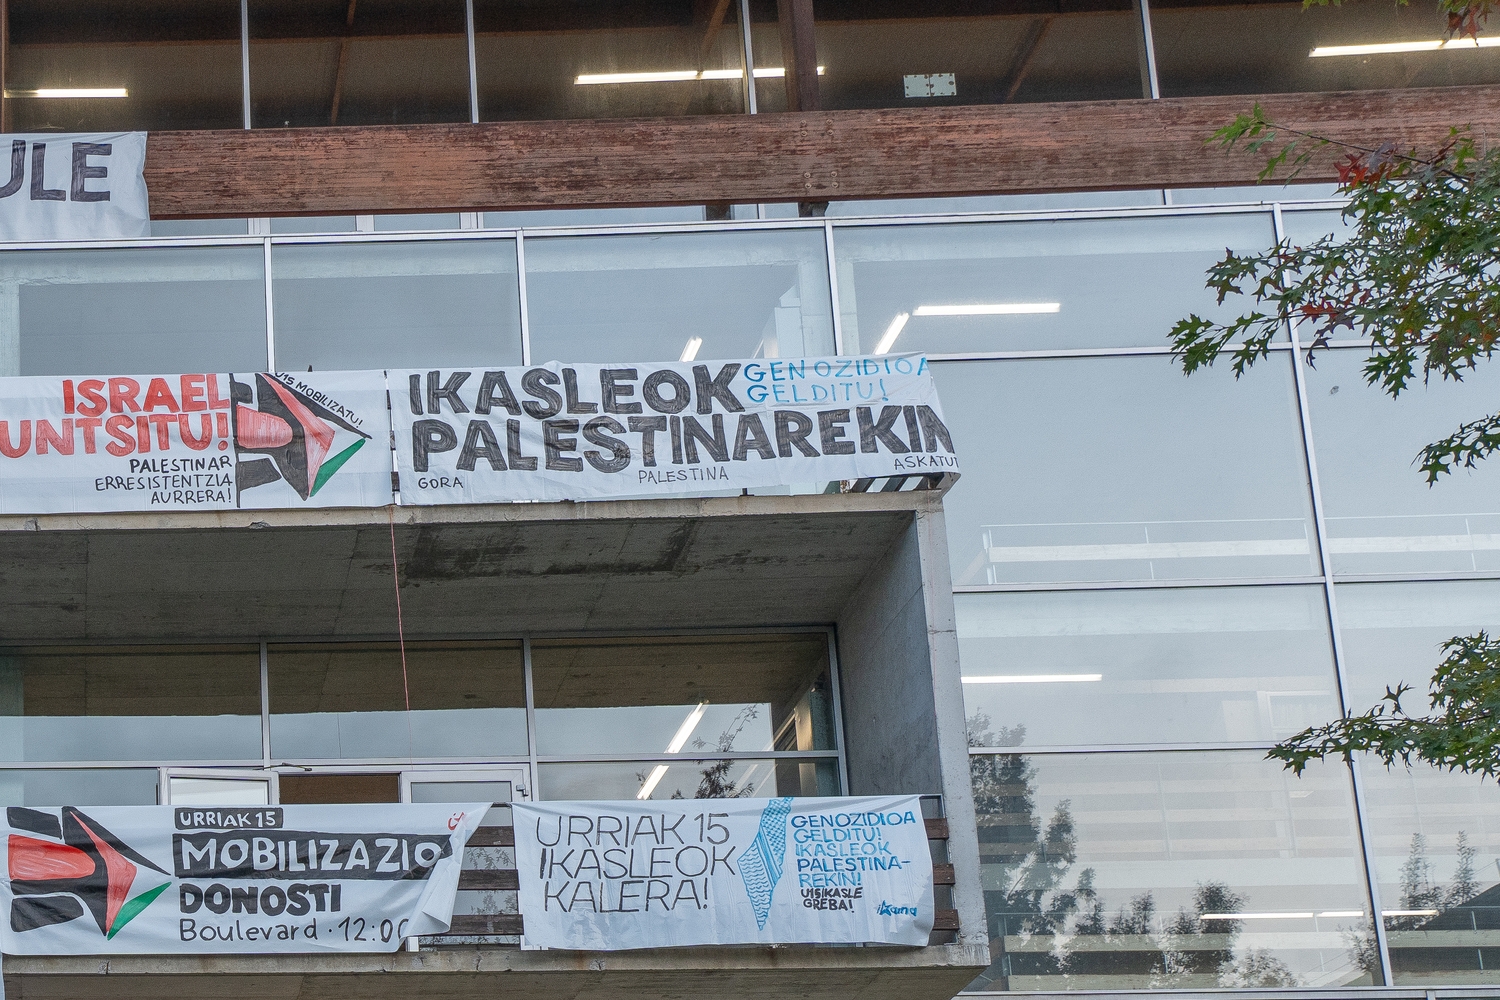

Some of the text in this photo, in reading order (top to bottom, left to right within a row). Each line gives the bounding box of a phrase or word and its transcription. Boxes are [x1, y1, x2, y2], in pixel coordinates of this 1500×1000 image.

[409, 357, 930, 419] IKASLEOK GENOZIDIOA
[746, 378, 889, 403] GELDITU!
[63, 373, 230, 417] ISRAEL
[295, 381, 364, 429] MOBILIZATU!
[412, 404, 956, 472] PALESTINAREKIN
[129, 455, 233, 475] PALESTINAR
[94, 473, 233, 492] ERRESISTENTZIA
[417, 467, 730, 491] GORA PALESTINA
[151, 490, 232, 505] AURRERA!
[180, 811, 276, 827] URRIAK 15
[536, 813, 730, 847] URRIAK 15
[791, 811, 916, 828] GENOZIDIOA
[793, 827, 882, 844] GELDITU!
[795, 841, 892, 857] IKASLEOK
[540, 845, 736, 880] IKASLEOK
[797, 856, 911, 872] PALESTINA-
[798, 871, 862, 888] REKIN!
[179, 883, 341, 916] DONOSTI
[544, 878, 708, 913] KALERA!
[803, 898, 854, 913] GREBA!
[179, 918, 318, 942] Boulevard
